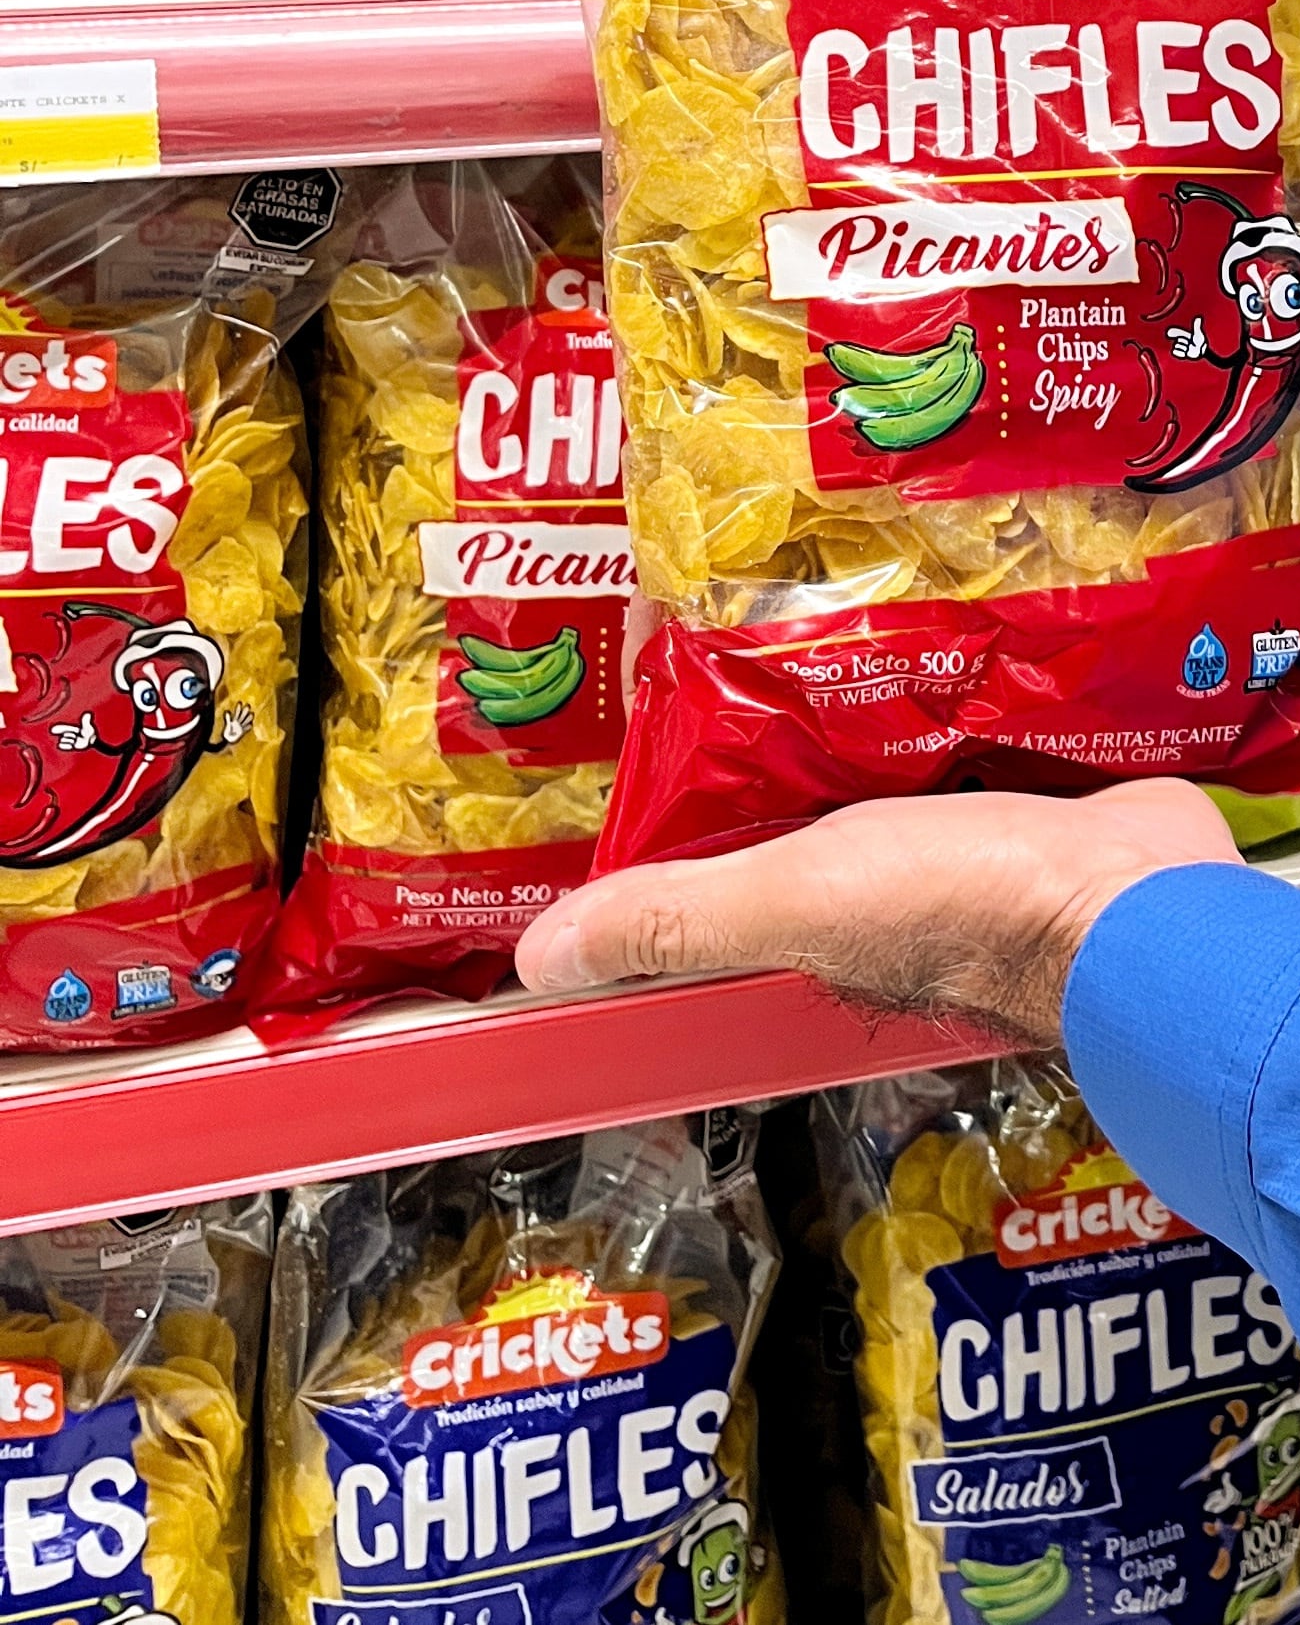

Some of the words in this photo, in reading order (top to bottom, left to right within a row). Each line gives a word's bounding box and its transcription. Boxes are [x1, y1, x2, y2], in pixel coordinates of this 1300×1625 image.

[116, 94, 127, 104] X
[799, 18, 1282, 163] CHIFLES
[253, 190, 319, 211] GRASAS
[256, 178, 298, 191] ALTO
[302, 182, 324, 197] EN
[237, 201, 329, 226] SATURADAS
[818, 211, 1119, 281] Picantes
[1019, 297, 1127, 330] Plantain
[1037, 334, 1109, 371] Chips
[1029, 373, 1122, 430] Spicy
[10, 413, 79, 433] calidad
[457, 530, 638, 587] Pican
[1255, 635, 1300, 653] GLUTEN
[851, 653, 911, 679] Neto
[917, 650, 965, 676] 500
[970, 652, 987, 675] g
[1187, 655, 1225, 673] TRANS
[1255, 653, 1299, 675] FREE
[1191, 669, 1219, 687] FAT
[839, 680, 909, 707] WEIGHT
[1091, 730, 1154, 751] FRITAS
[1130, 747, 1183, 763] CHIPS
[396, 885, 445, 907] Peso
[452, 886, 504, 907] Neto
[510, 883, 551, 906] 500
[402, 912, 434, 927] NET
[440, 912, 502, 927] WEIGHT
[121, 969, 169, 984] GLUTEN
[123, 981, 169, 1003] FREE
[1026, 1251, 1097, 1287] Tradición
[1098, 1251, 1141, 1275] sabor
[1144, 1253, 1157, 1271] y
[1157, 1241, 1211, 1265] calidad
[409, 1304, 664, 1391] Crickets
[940, 1272, 1296, 1422] CHIFLES
[433, 1397, 515, 1428] Tradición
[516, 1392, 564, 1411] sabor
[565, 1389, 579, 1410] y
[582, 1372, 645, 1399] calidad
[336, 1388, 732, 1572] CHIFLES
[930, 1460, 1089, 1517] Salados
[1105, 1520, 1186, 1561] Plantain
[1119, 1555, 1178, 1583] Chips
[1111, 1577, 1187, 1616] Salted
